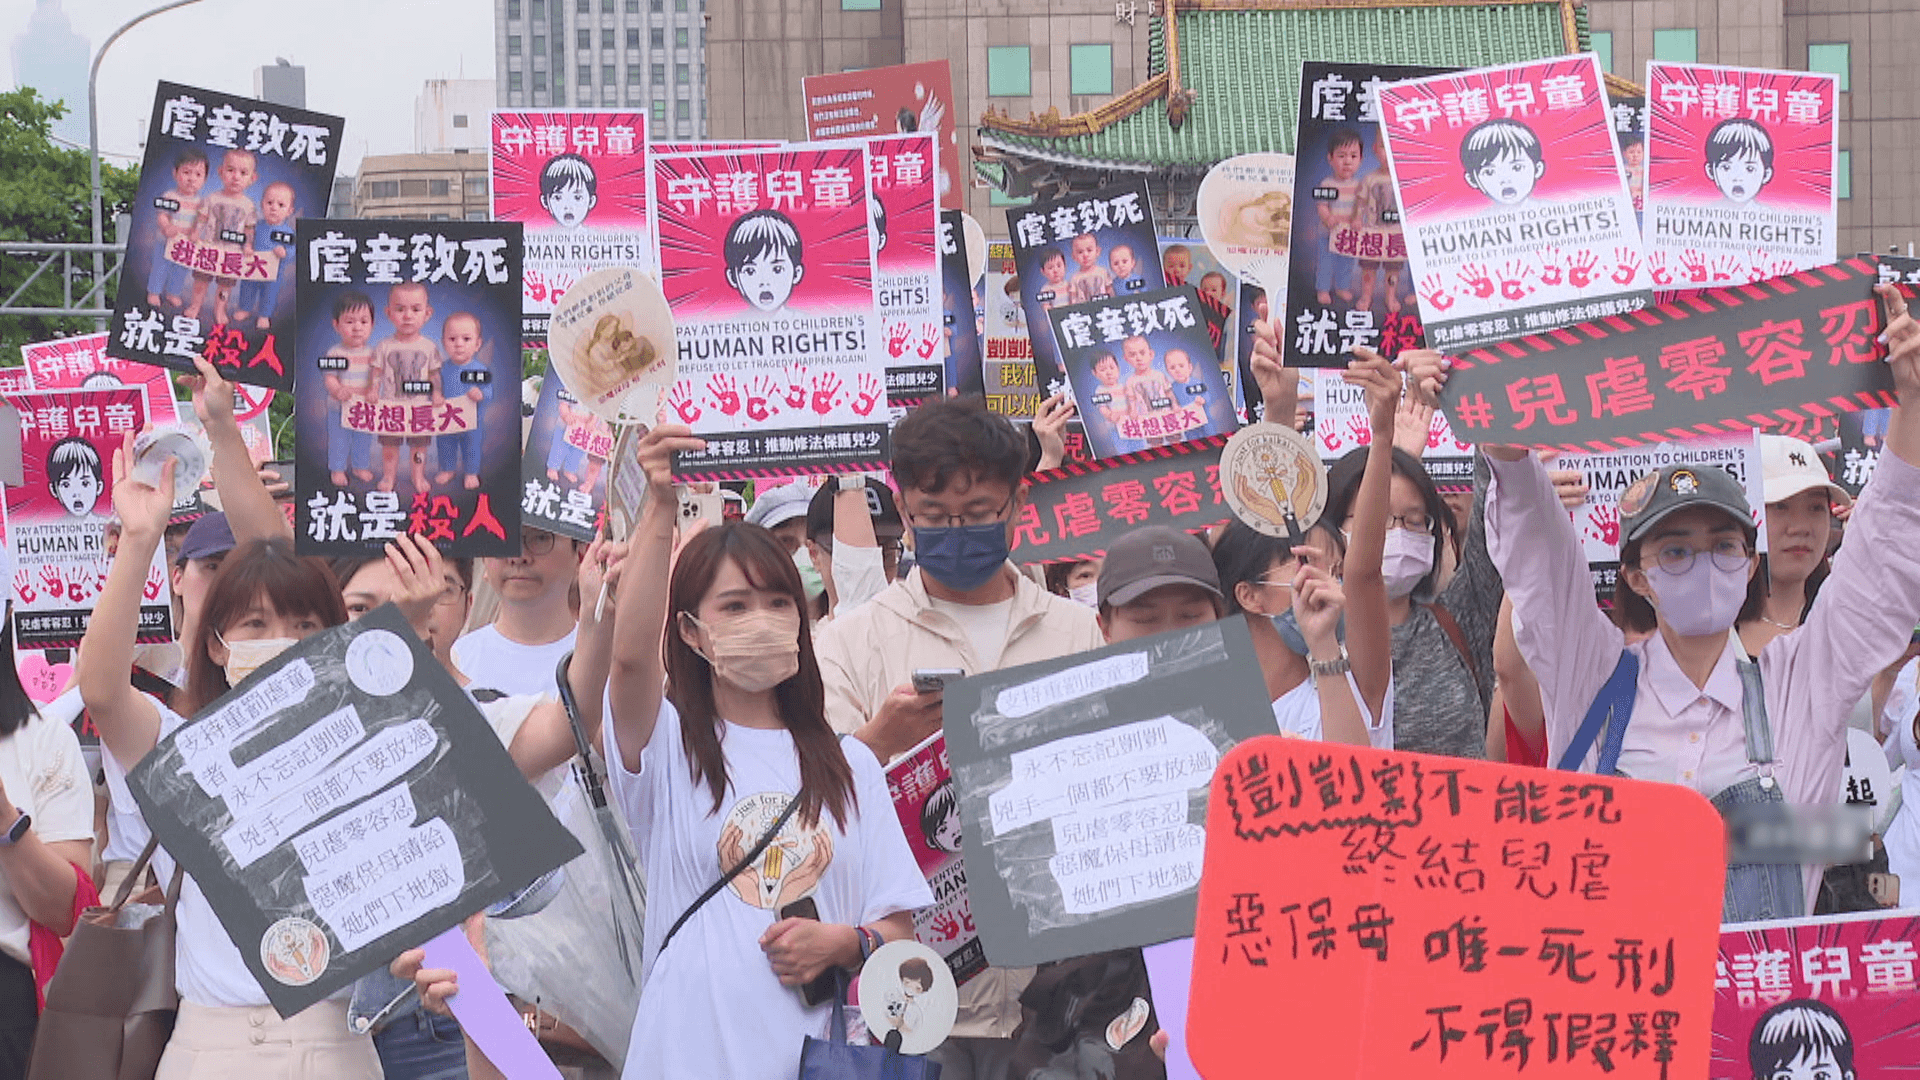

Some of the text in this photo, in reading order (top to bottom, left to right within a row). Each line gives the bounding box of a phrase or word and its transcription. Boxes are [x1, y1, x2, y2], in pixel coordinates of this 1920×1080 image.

[1394, 73, 1587, 134] 守護兒童
[1660, 80, 1823, 126] 守護兒童
[161, 95, 331, 166] 虐童致死
[499, 124, 636, 157] 守護兒童
[667, 166, 854, 216] 守護兒童
[1017, 192, 1143, 248] 虐童致死
[1419, 197, 1616, 237] PAY ATTENTION TO CHILDREN'S
[1421, 209, 1620, 257] HUMAN RIGHTS!
[1656, 205, 1823, 226] PAY ATTENTION TO CHILDREN'S
[1656, 217, 1822, 246] HUMAN RIGHTS!
[171, 239, 268, 278] 我想長大
[308, 232, 509, 284] 虐童致死
[571, 244, 640, 260] RIGHTS!
[120, 307, 285, 378] 就是殺人
[676, 315, 865, 337] PAY ATTENTION TO CHILDREN'S
[678, 329, 867, 360] HUMAN RIGHTS!
[1060, 295, 1196, 348] 虐童致死
[678, 362, 715, 374] REFUSE
[717, 361, 730, 371] TO
[731, 360, 748, 371] LET
[751, 358, 794, 370] TRAGEDY
[835, 354, 867, 365] AGAIN!
[1455, 298, 1885, 430] #兒虐零容忍
[347, 401, 467, 432] 我想長大
[1123, 409, 1201, 438] 我想長大
[1559, 447, 1745, 470] PAY ATTENTION TO CHILDREN'S
[16, 523, 96, 536] PAY ATTENTION TO
[307, 491, 507, 542] 就是殺人
[17, 536, 79, 554] HUMAN
[202, 761, 228, 788] 者
[231, 715, 360, 808] 永不忘記剴剴
[1025, 724, 1168, 779] 永不忘記剴剴
[240, 724, 434, 849] 兇手一個都不要放過
[760, 795, 777, 804] for
[994, 752, 1212, 826] 兇手一個都不要放過
[299, 794, 413, 870] 兒虐零容忍
[1063, 800, 1185, 845] 兒虐零容忍
[312, 827, 446, 910] 惡魔保母請給
[1055, 828, 1201, 876] 惡魔保母請給
[1341, 825, 1611, 900] 終結兒虐
[341, 864, 455, 935] 她們下地獄
[1072, 861, 1197, 907] 她們下地獄
[1223, 892, 1675, 995] 惡保母 唯一死刑
[1715, 939, 1918, 1010] 護兒童
[1409, 997, 1679, 1079] 不得假釋
